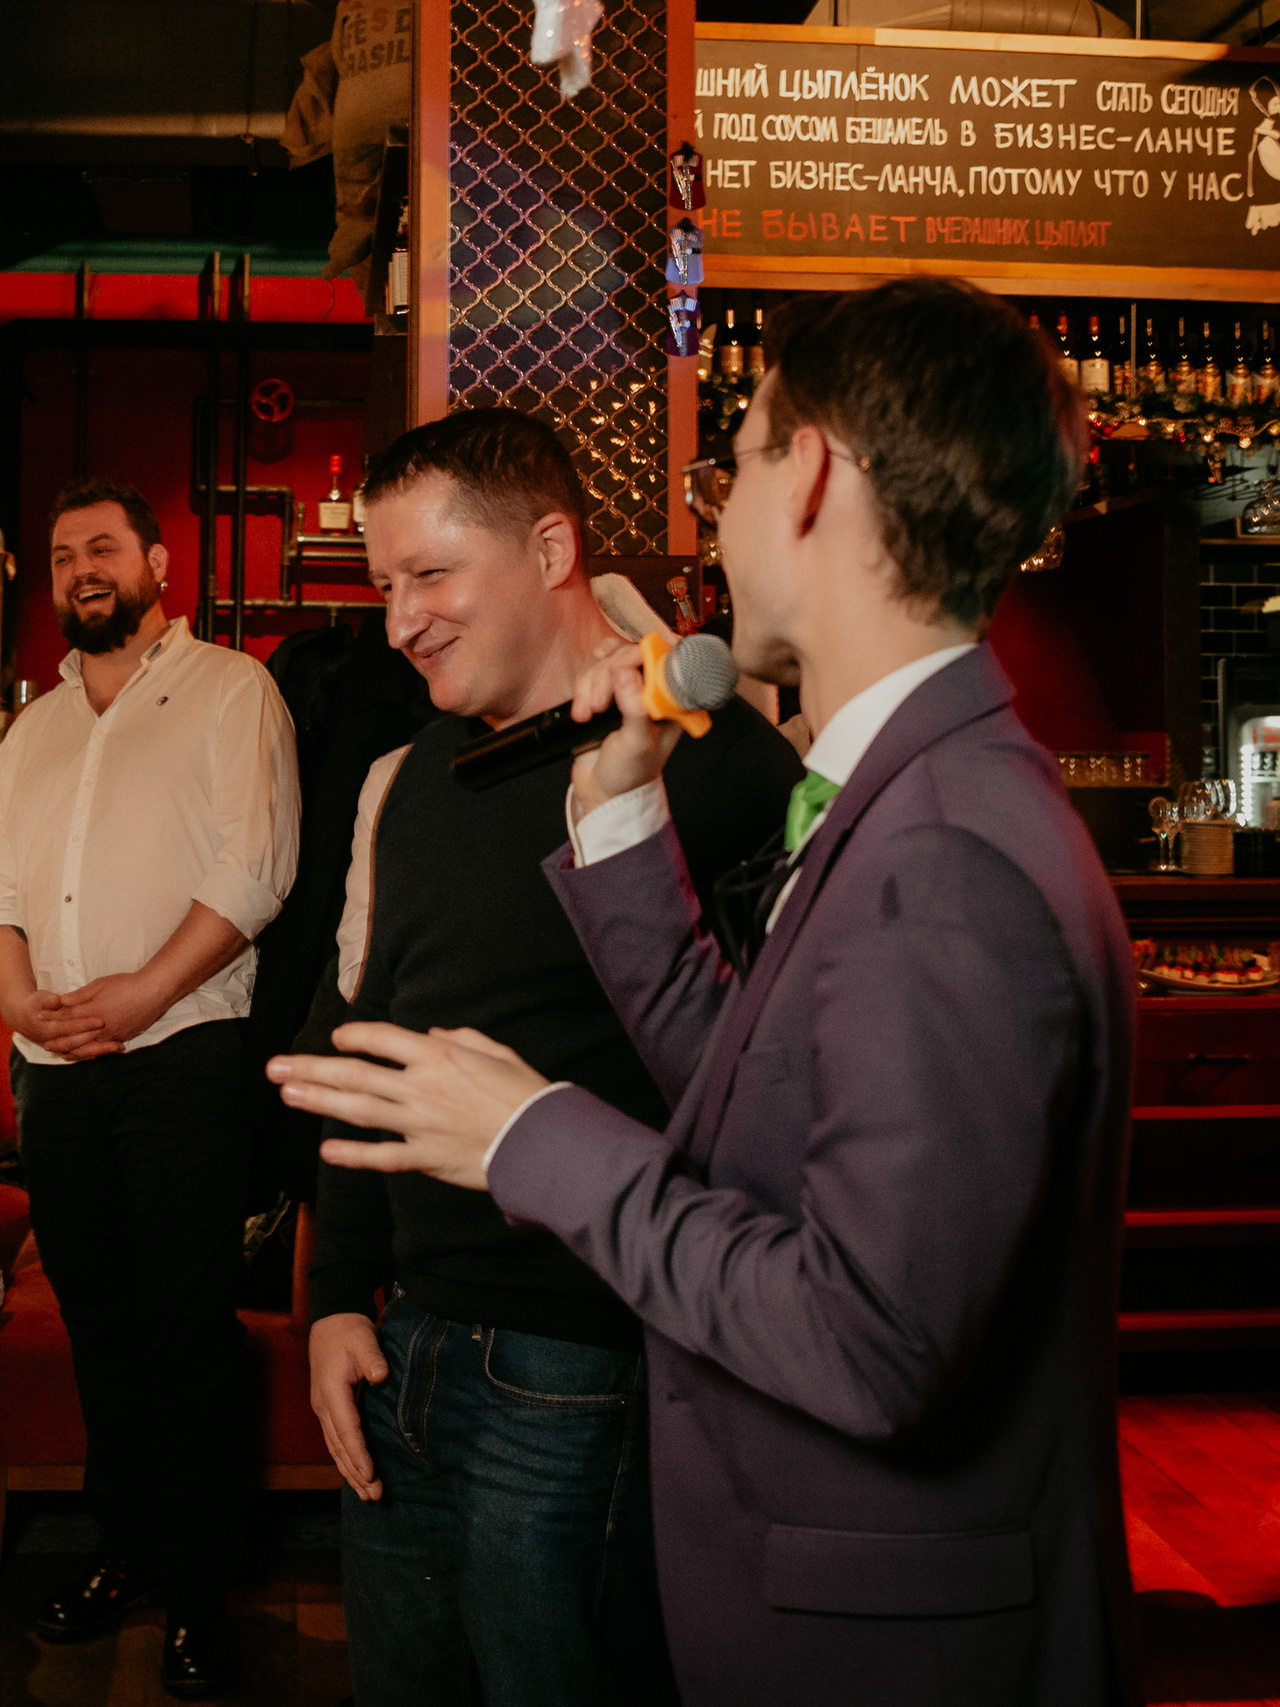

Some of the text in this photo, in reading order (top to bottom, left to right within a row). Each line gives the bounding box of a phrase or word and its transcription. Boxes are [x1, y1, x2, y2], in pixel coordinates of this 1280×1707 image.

[695, 62, 1240, 120] ШНИЙ ЦЫПЛЁНОК МОЖЕТ СТАТЬ СЕГОДНЯ
[713, 113, 758, 143] ПОД
[762, 114, 839, 143] СОУСОМ
[845, 116, 948, 146] БЕШАМЕЛЬ
[960, 120, 977, 147] В
[994, 122, 1236, 156] БИЗНЕС-ЛАНЧЕ
[706, 159, 757, 188] НЕТ
[969, 165, 1082, 196] ПОТОМУ
[1094, 168, 1149, 198] ЧТО
[1161, 170, 1177, 198] У
[1188, 171, 1244, 202] НАС
[697, 208, 1113, 250] НЕ БЫВАЕТ ВЧЕРАШНИХ ЦЫПЛЯТ
